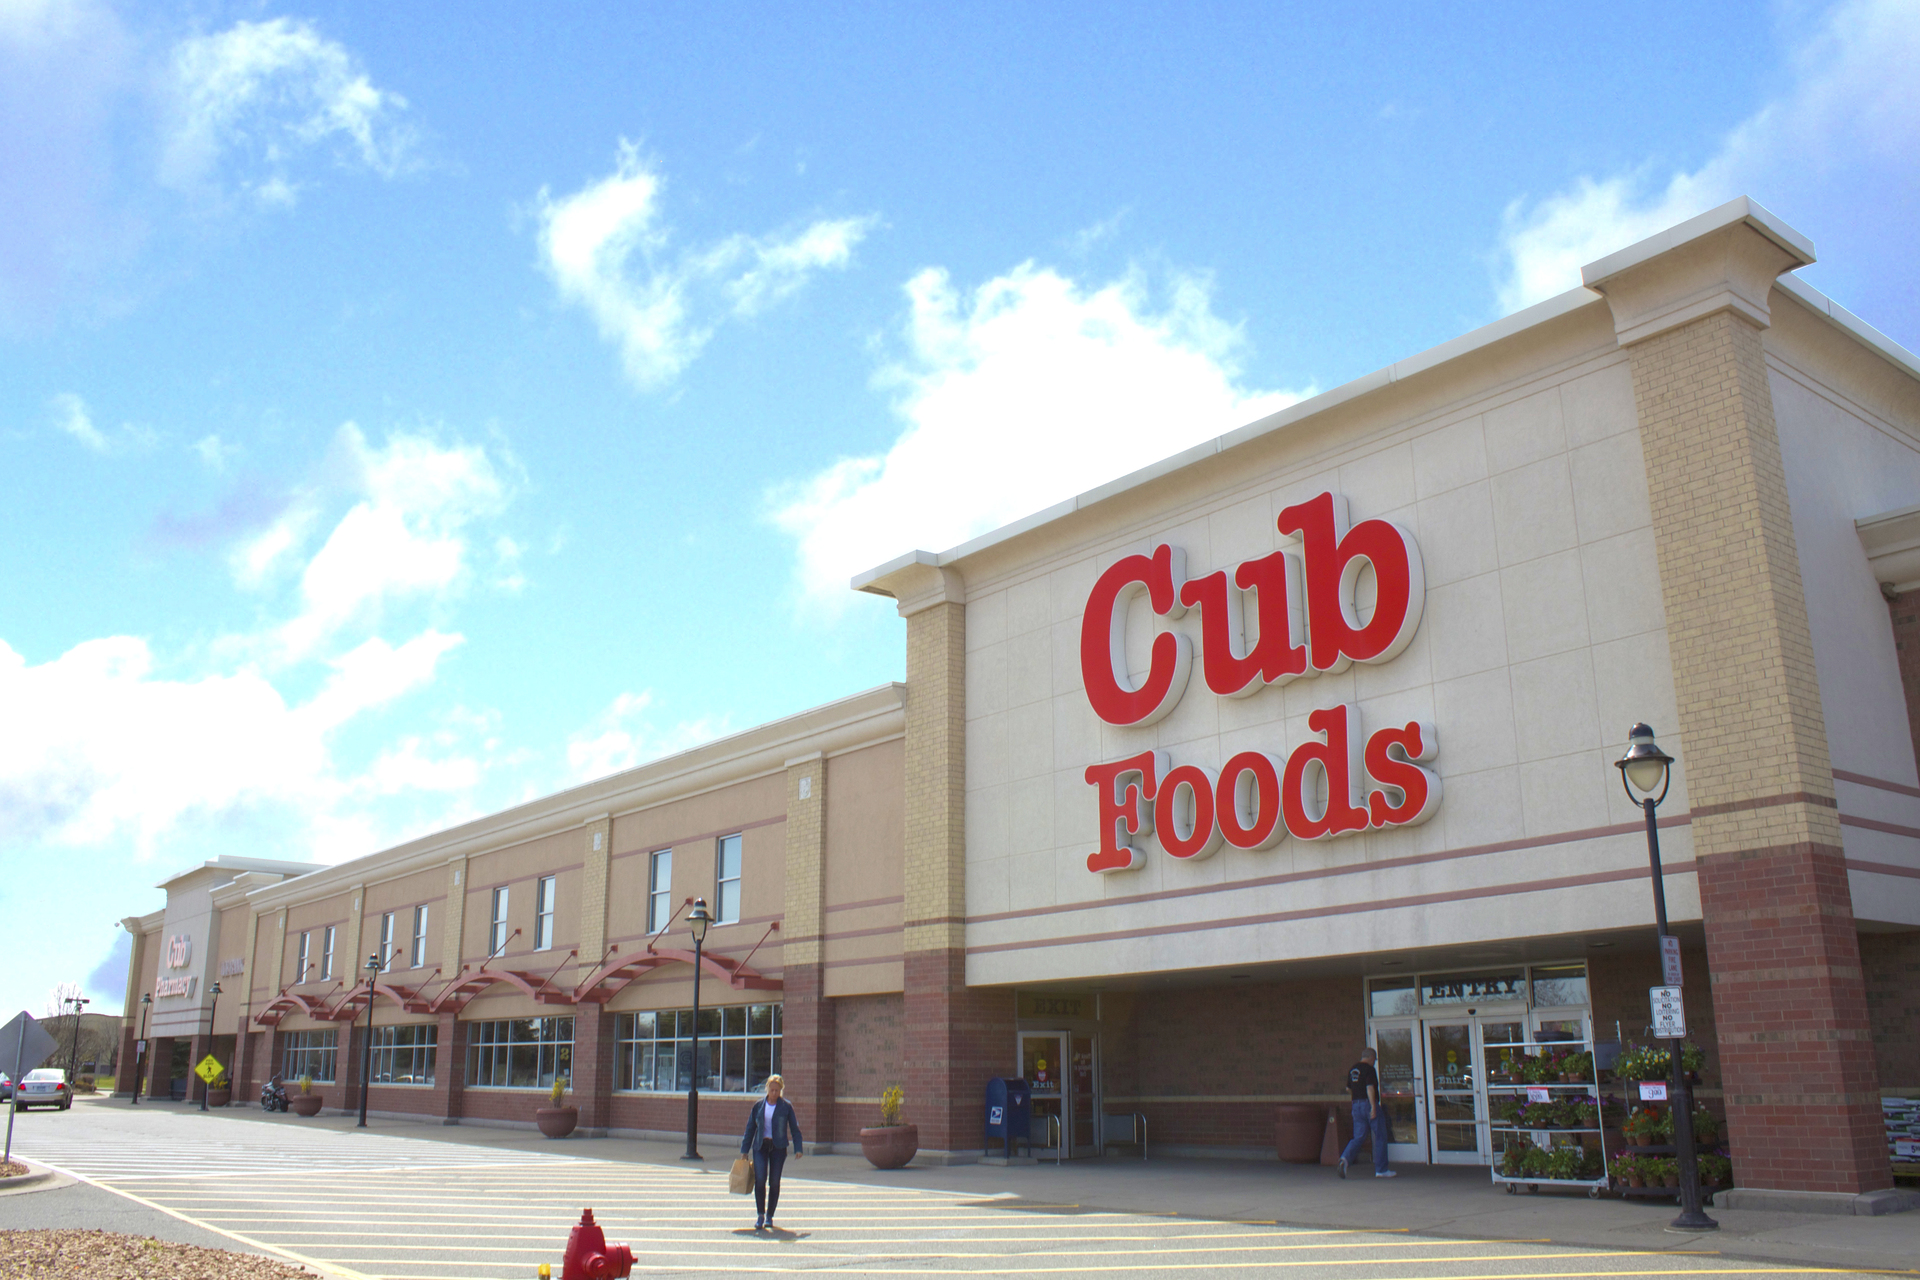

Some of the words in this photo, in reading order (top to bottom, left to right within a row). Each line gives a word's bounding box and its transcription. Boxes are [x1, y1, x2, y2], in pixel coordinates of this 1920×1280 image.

[1081, 491, 1420, 727] Cub
[1085, 703, 1438, 873] Foods
[167, 935, 190, 969] Cub
[155, 975, 196, 999] Pharmacy
[1430, 976, 1519, 998] ENTRY
[1034, 998, 1081, 1015] EXIT
[1032, 1080, 1054, 1089] Exit
